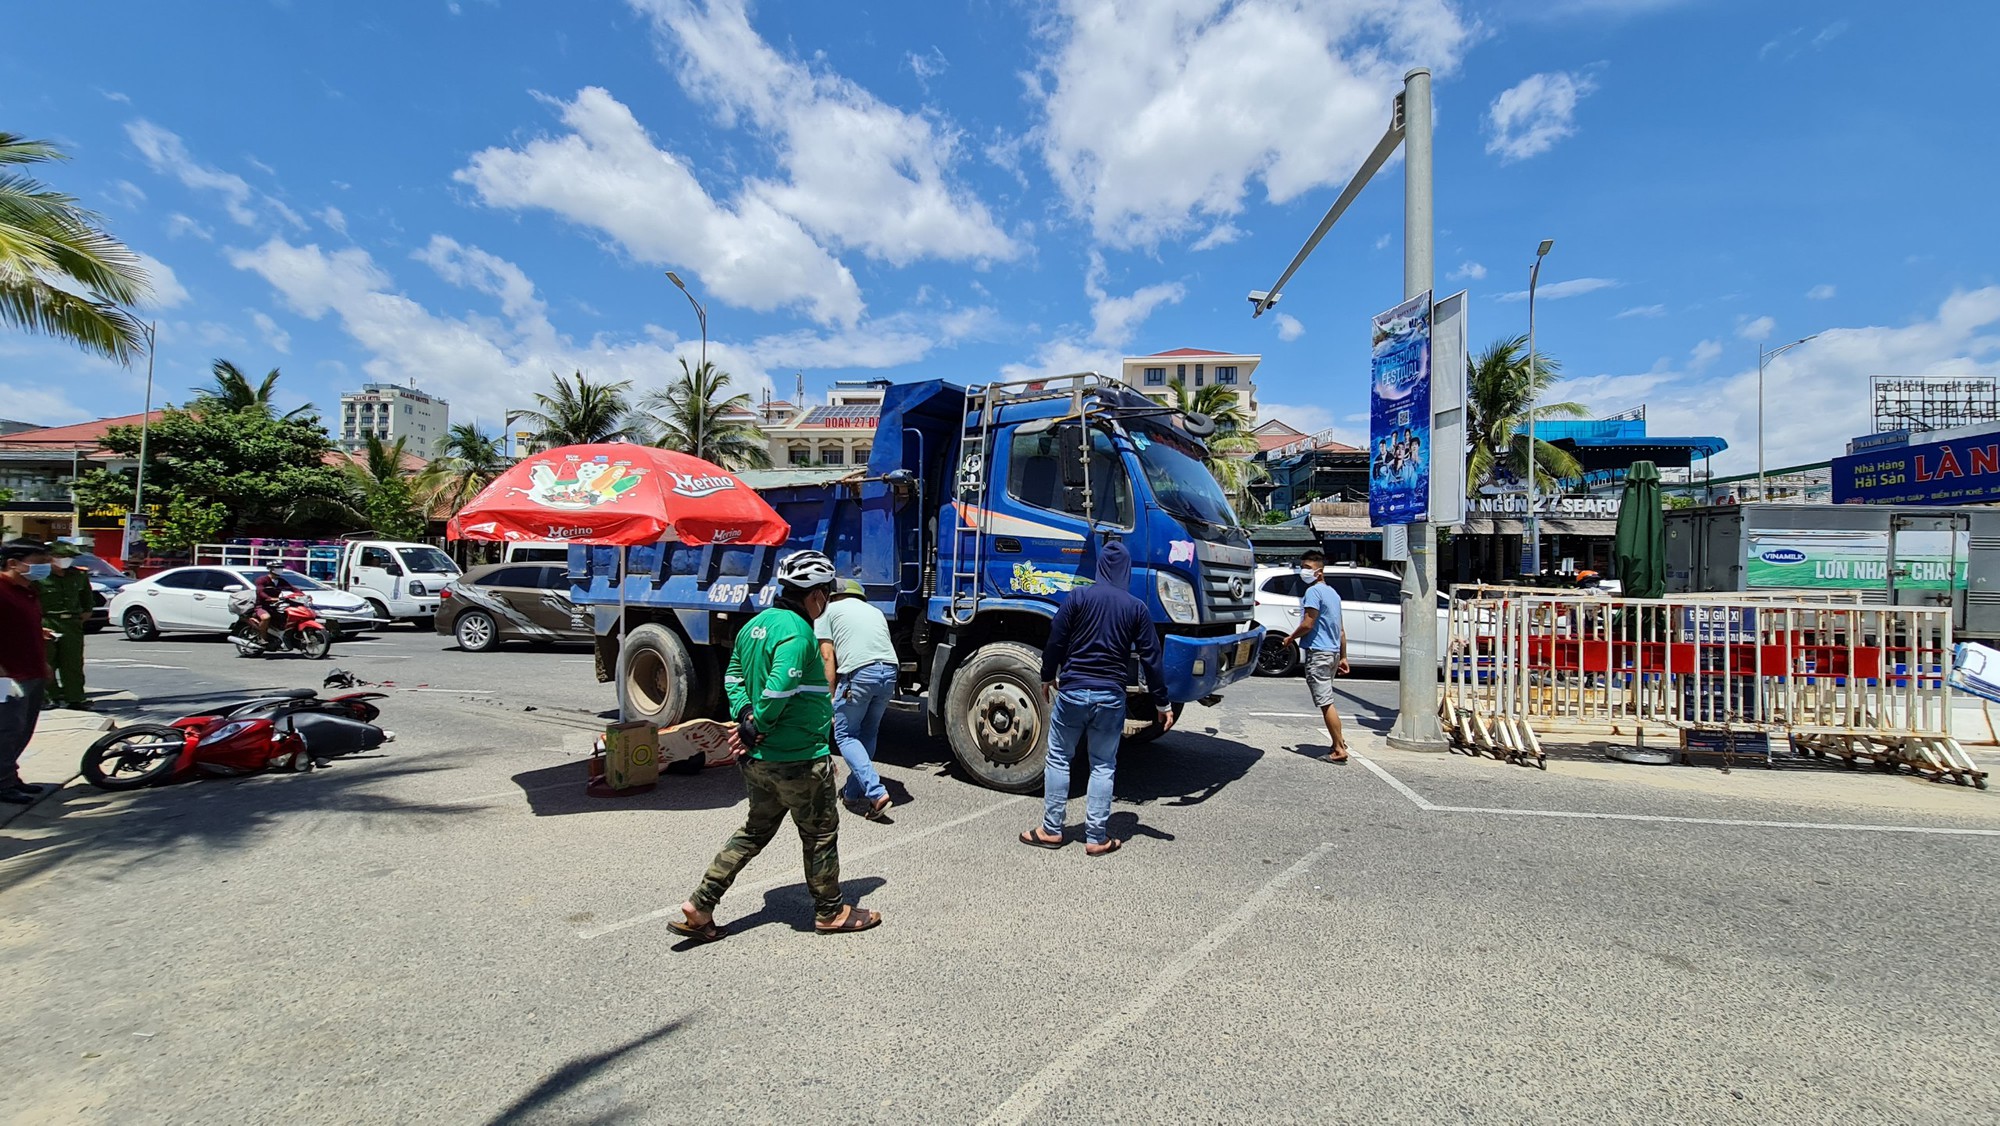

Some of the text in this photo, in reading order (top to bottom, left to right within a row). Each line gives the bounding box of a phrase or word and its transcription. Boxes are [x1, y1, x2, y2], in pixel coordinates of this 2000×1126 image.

[1382, 361, 1420, 386] FESTIVAL
[854, 417, 865, 428] 27
[1854, 460, 1905, 474] Nhà Hàng
[665, 471, 737, 493] Merino
[1855, 472, 1905, 488] Hải Sản
[1533, 495, 1560, 512] 27
[548, 526, 593, 538] Merino
[714, 528, 742, 540] Merino
[1764, 552, 1804, 560] VINAMILK
[708, 584, 776, 606] 43C-151 97
